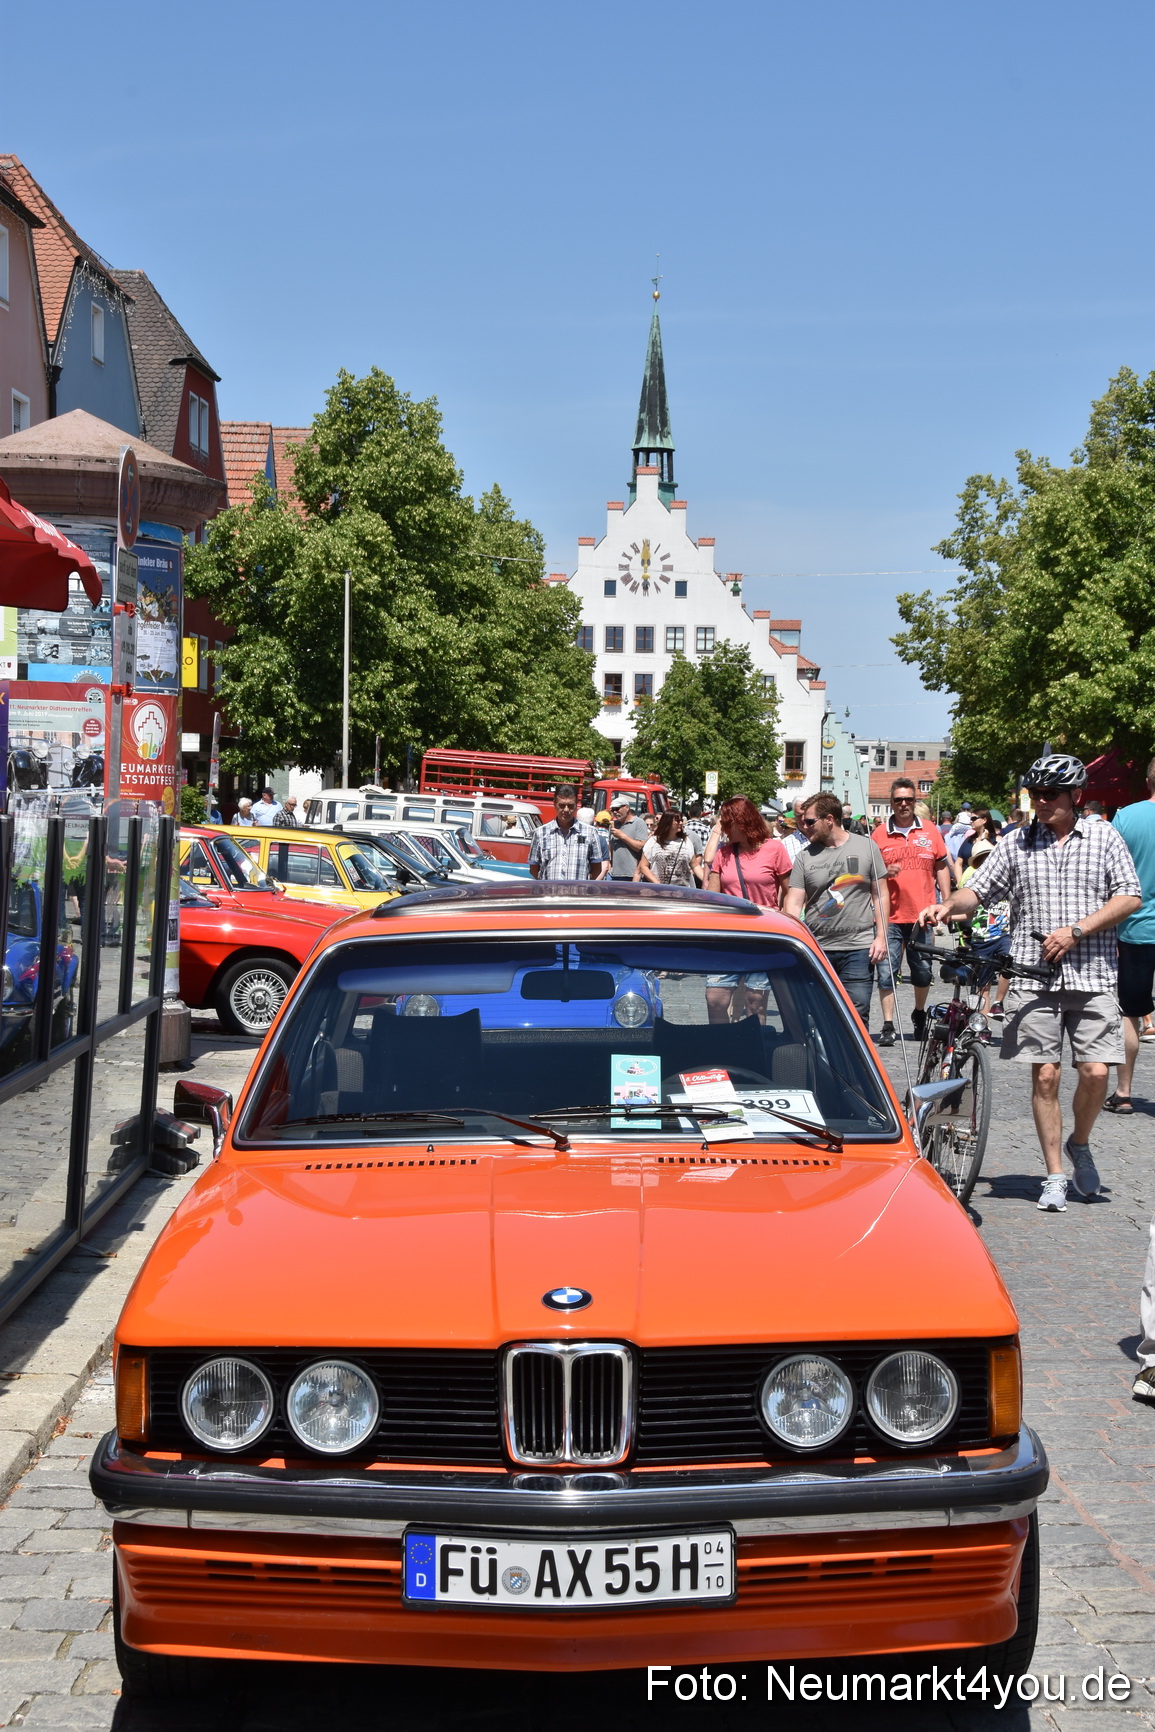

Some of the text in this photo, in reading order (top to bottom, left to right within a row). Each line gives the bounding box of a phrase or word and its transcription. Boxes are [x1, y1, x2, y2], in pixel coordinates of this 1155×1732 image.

[138, 556, 155, 568] inkler
[121, 763, 175, 775] EUMARKTER
[120, 775, 175, 786] LTSTADTFEST
[810, 860, 845, 871] Lovely day
[742, 1098, 791, 1110] 399
[703, 1541, 724, 1555] 04
[415, 1573, 427, 1588] D
[704, 1575, 725, 1589] 10
